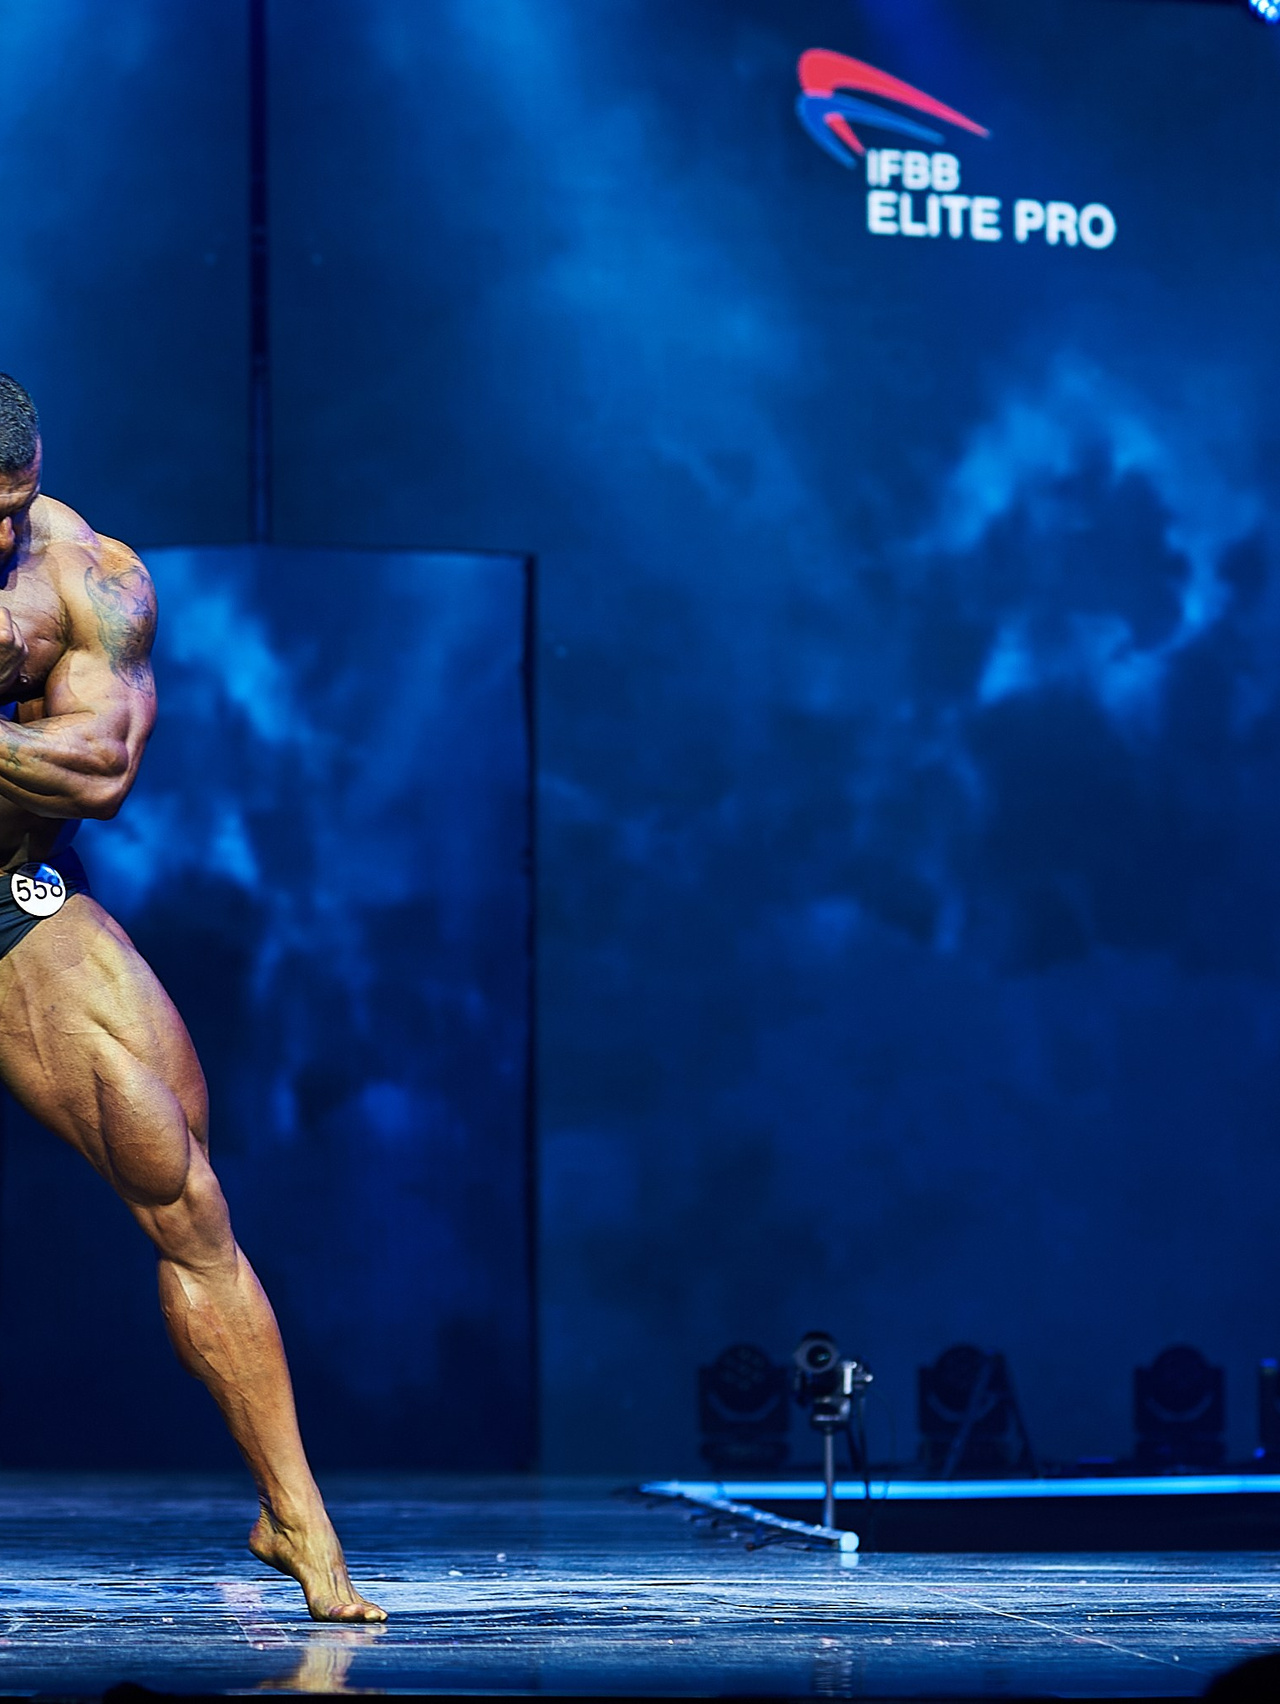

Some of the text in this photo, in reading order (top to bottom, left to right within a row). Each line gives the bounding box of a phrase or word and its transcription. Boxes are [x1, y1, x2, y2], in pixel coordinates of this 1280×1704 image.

[866, 148, 960, 191] IFBB
[866, 190, 1116, 249] ELITE PRO
[16, 875, 63, 902] 558
